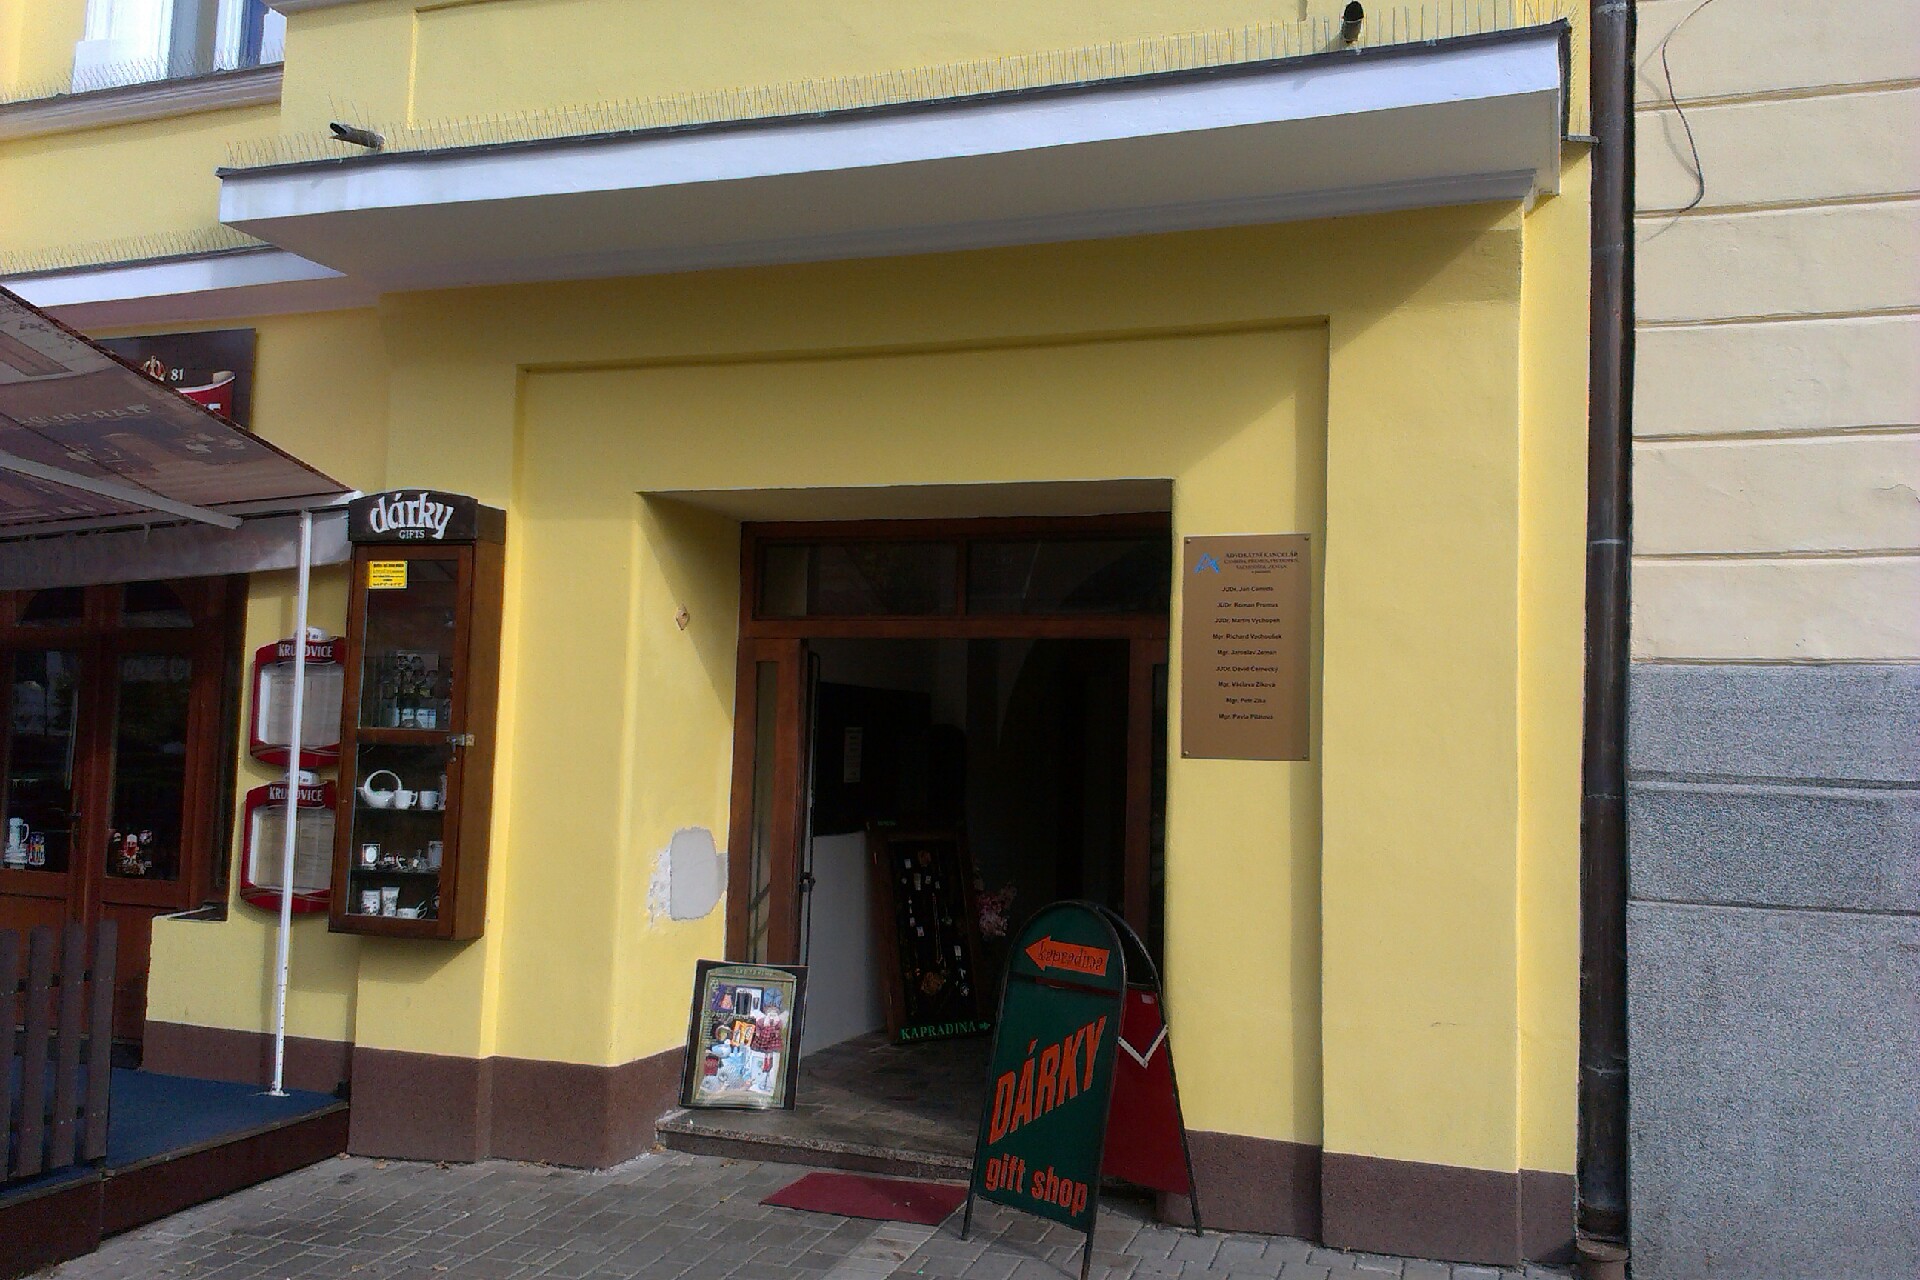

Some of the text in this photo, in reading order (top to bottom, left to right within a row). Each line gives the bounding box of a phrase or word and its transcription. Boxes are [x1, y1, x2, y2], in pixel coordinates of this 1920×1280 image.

[170, 368, 184, 382] 81
[370, 493, 454, 539] dárky
[399, 529, 425, 539] GIFTS
[278, 643, 333, 657] KRUOVICE
[269, 786, 323, 801] KRUOVICE
[901, 1021, 976, 1040] KAPRADINA
[988, 1016, 1107, 1145] DÁRKY
[985, 1153, 1088, 1217] gift shop
